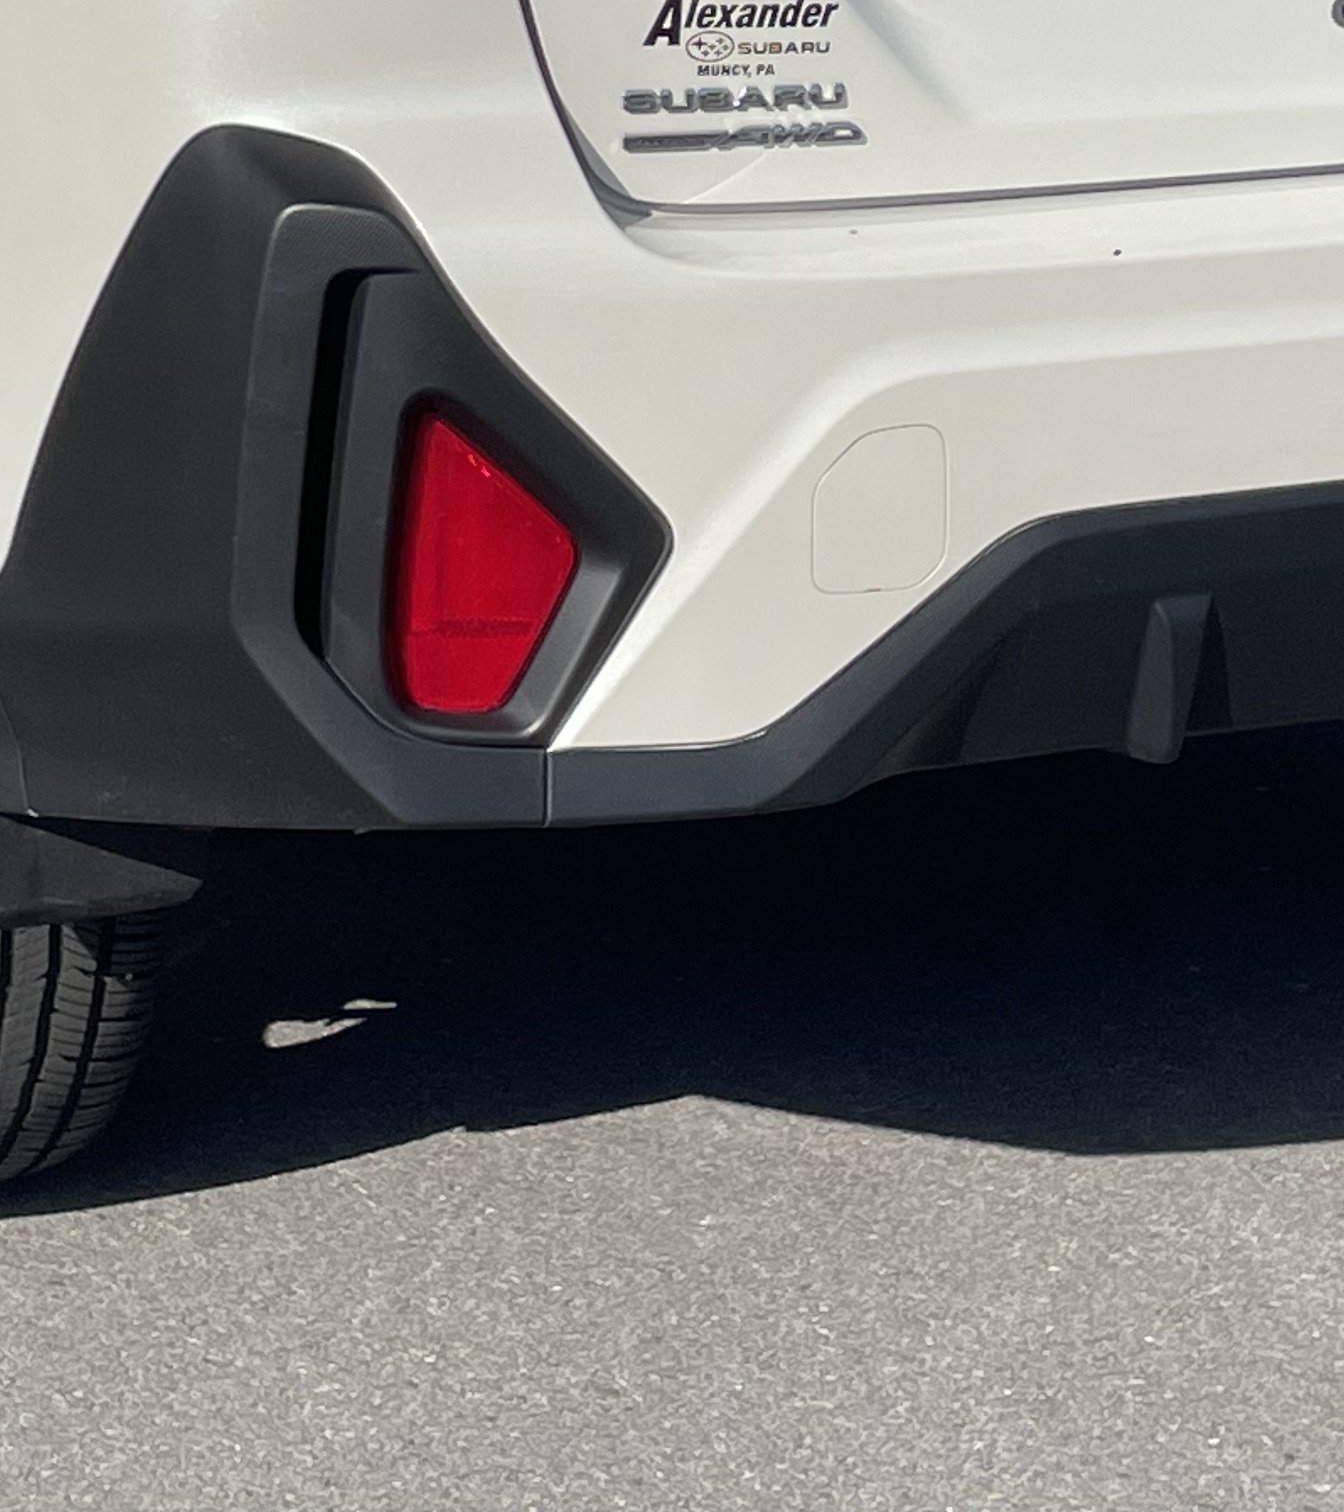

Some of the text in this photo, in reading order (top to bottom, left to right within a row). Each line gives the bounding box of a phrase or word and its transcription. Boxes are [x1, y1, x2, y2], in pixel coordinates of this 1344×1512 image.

[737, 40, 831, 54] SUBARU
[697, 63, 775, 78] MUNCY, PA
[622, 83, 849, 114] SUBARU
